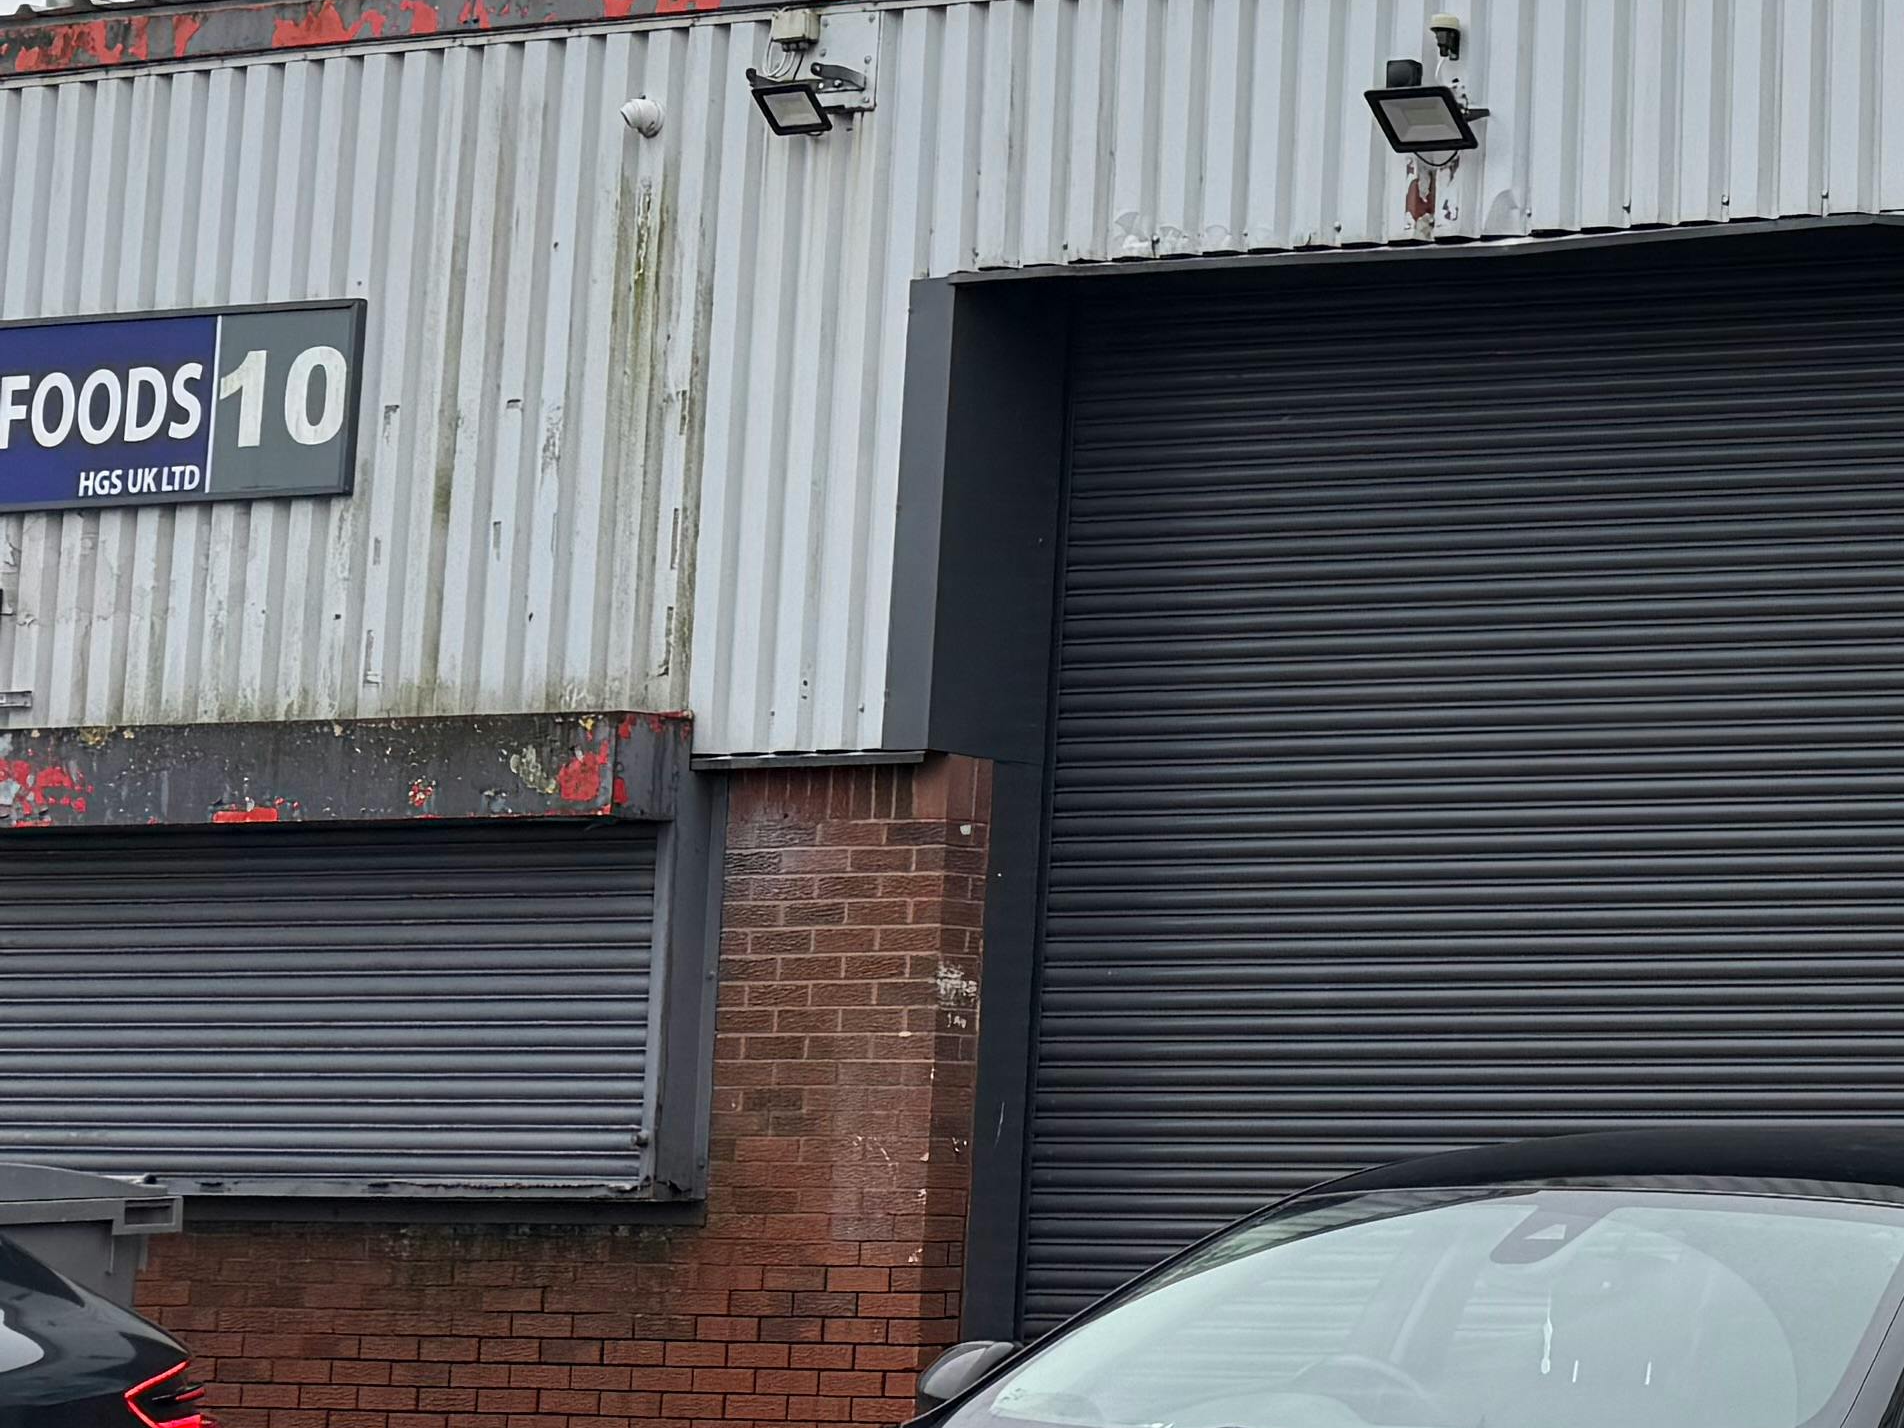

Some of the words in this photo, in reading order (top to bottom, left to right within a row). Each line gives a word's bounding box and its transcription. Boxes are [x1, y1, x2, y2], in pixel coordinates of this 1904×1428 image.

[0, 362, 203, 449] FOODS
[219, 345, 347, 448] 10
[78, 469, 122, 497] HGS
[127, 467, 160, 493] UK
[161, 465, 200, 492] LTD
